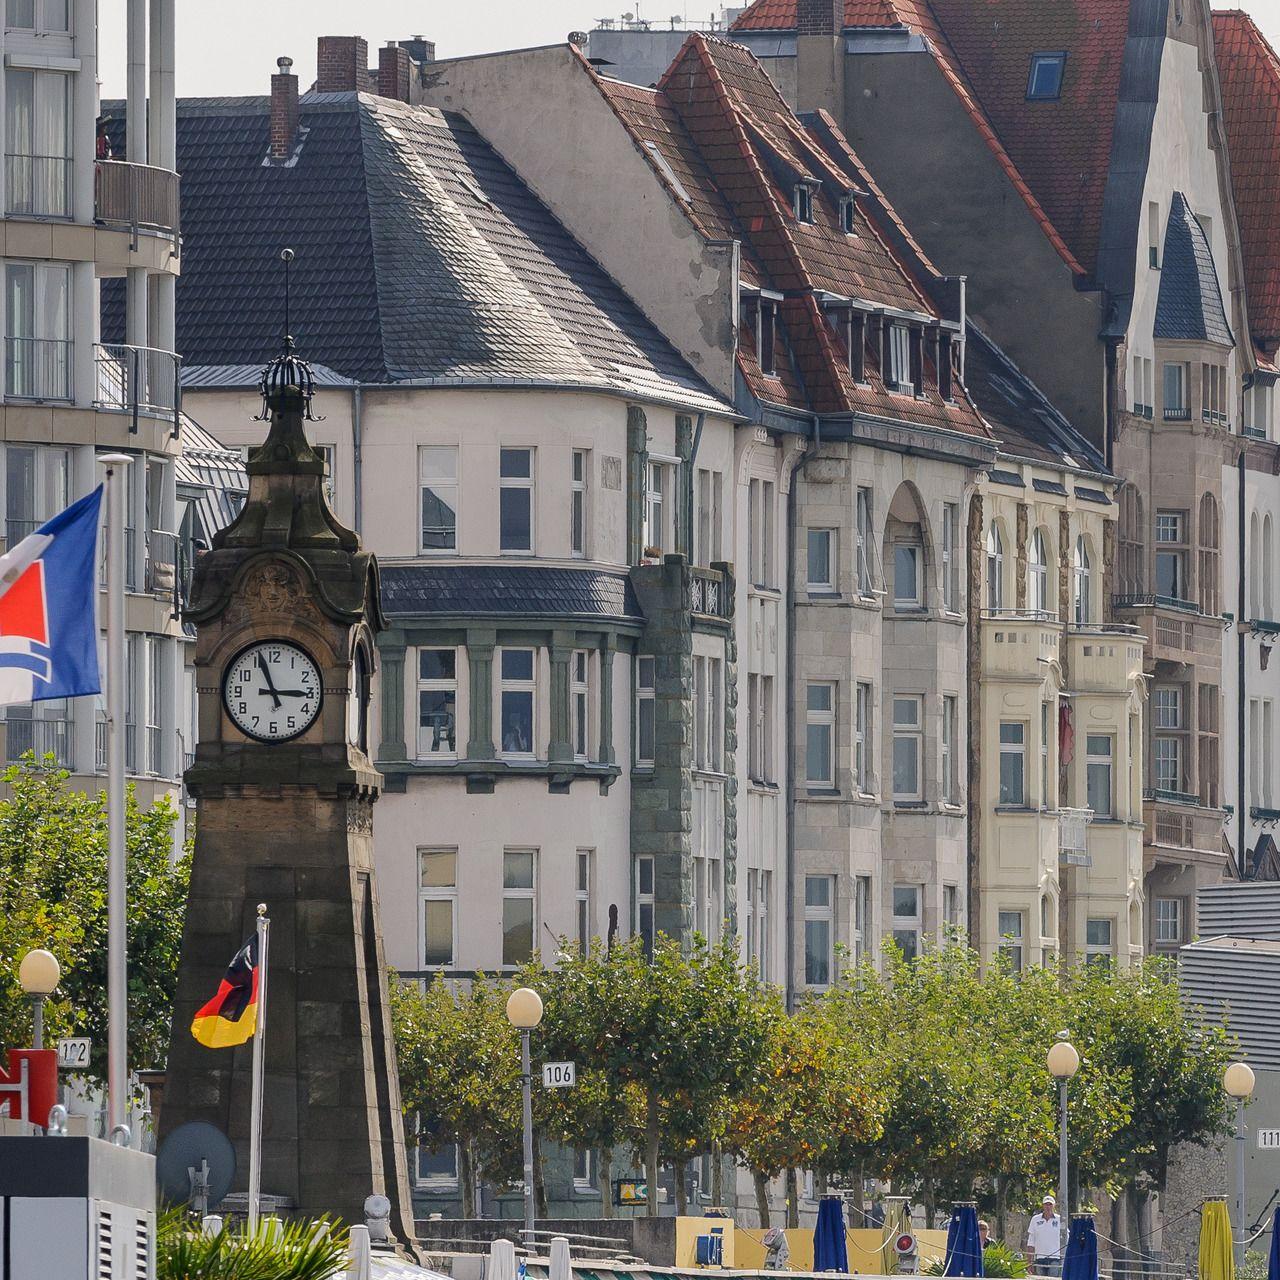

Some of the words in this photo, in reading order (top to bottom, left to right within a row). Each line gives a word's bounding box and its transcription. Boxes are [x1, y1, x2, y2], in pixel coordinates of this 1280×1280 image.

[269, 651, 281, 663] 12
[240, 670, 251, 682] 10
[301, 671, 309, 683] 2
[234, 686, 242, 698] 9
[306, 687, 314, 699] 3
[239, 702, 247, 714] 8
[300, 703, 309, 715] 4
[252, 716, 260, 728] 7
[269, 722, 278, 734] 6
[287, 716, 295, 728] 5
[546, 1066, 571, 1083] 106
[1262, 1132, 1280, 1146] 111
